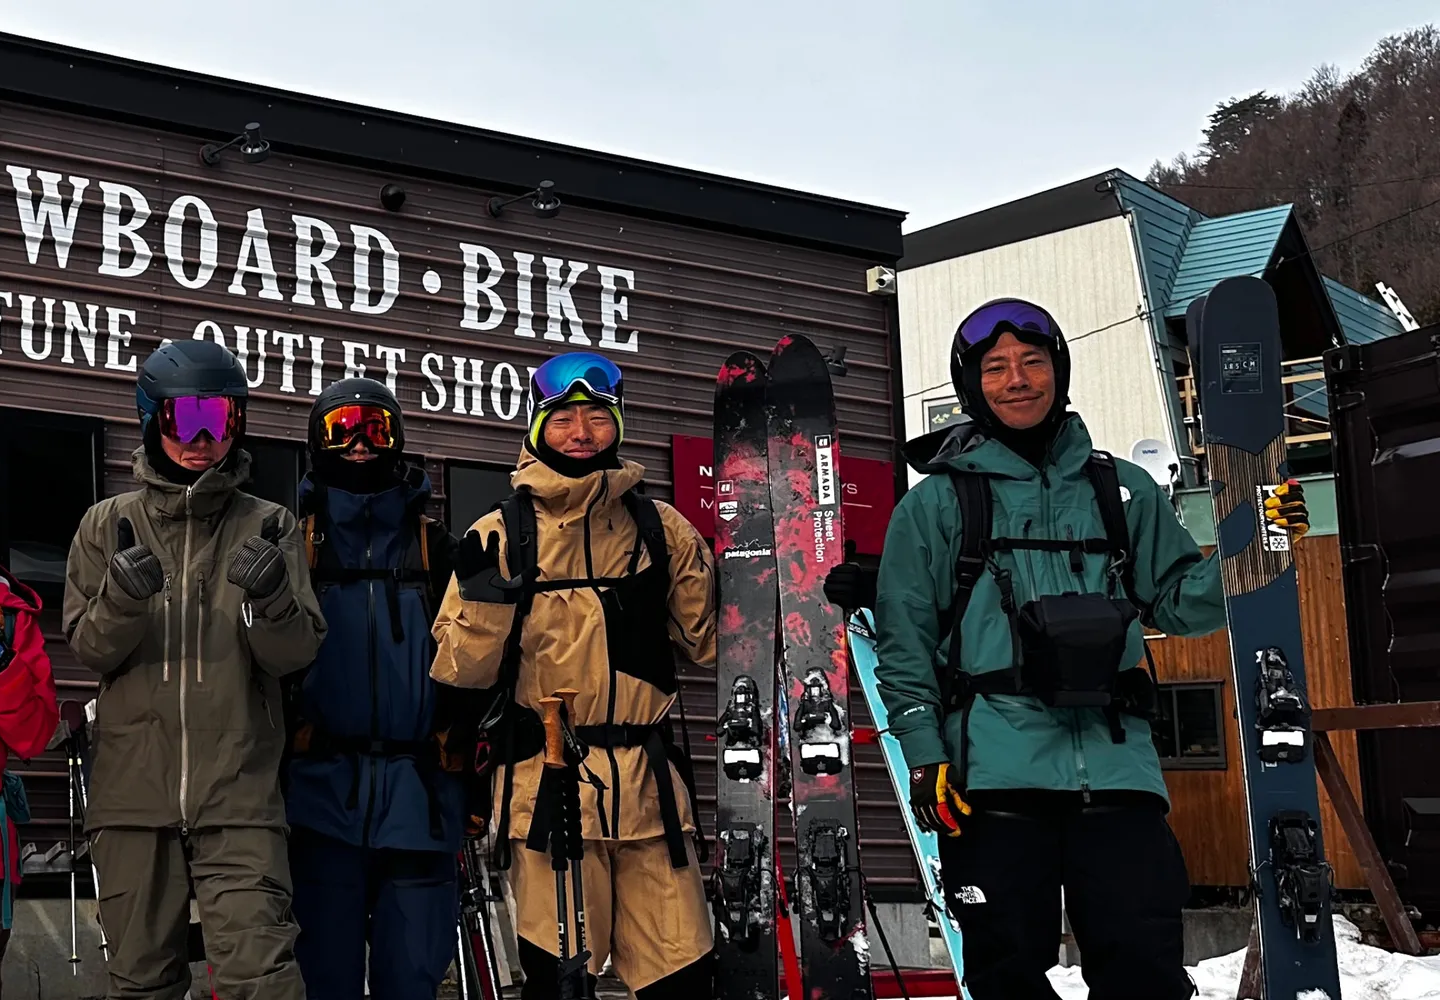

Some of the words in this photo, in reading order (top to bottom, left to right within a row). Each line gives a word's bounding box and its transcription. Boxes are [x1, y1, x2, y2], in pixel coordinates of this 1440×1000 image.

[458, 242, 639, 352] BIKE
[420, 352, 539, 421] SHO
[820, 454, 831, 500] ARMADA
[813, 511, 826, 563] Protection
[824, 510, 836, 542] Sweet
[724, 548, 772, 559] patagonia
